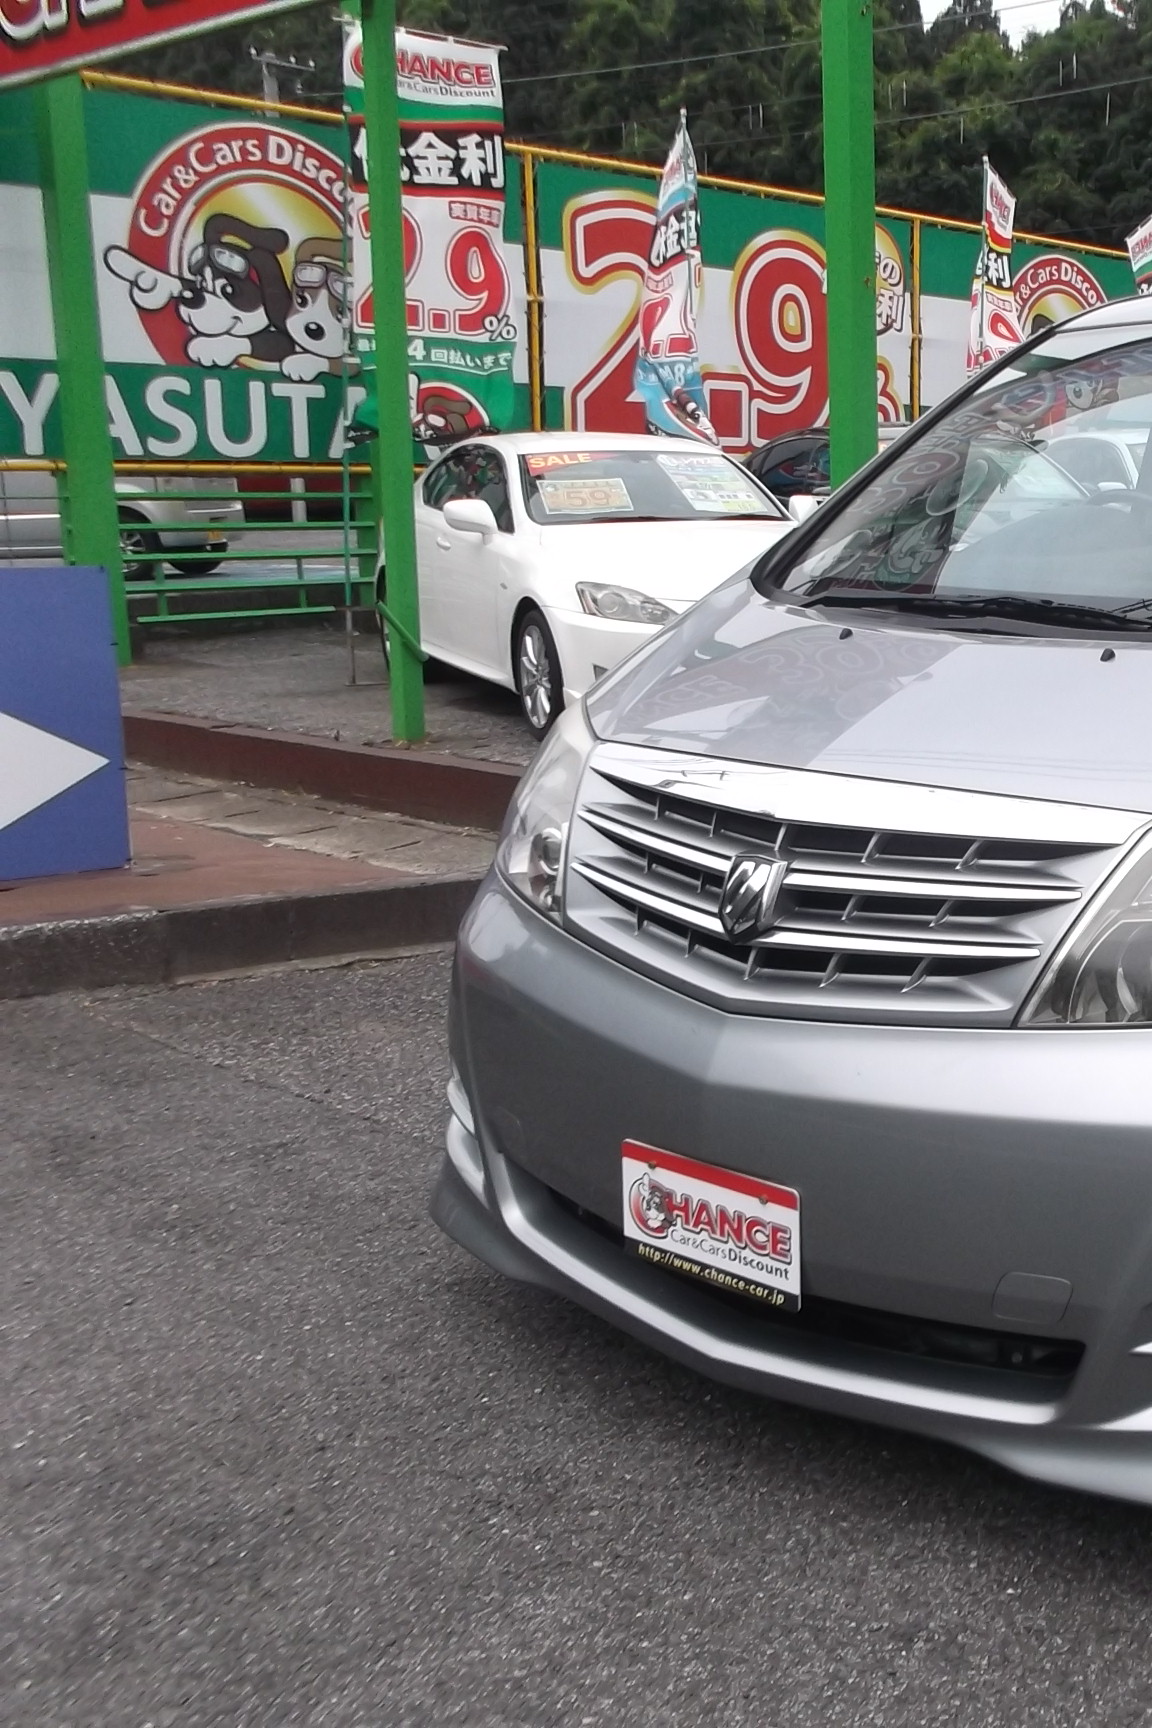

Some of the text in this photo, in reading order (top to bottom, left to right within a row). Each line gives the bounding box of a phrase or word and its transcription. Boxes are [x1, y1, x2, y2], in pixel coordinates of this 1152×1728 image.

[529, 452, 594, 469] SALE
[628, 1172, 793, 1266] CHANCE
[637, 1243, 786, 1306] http://www.chance-car.jp
